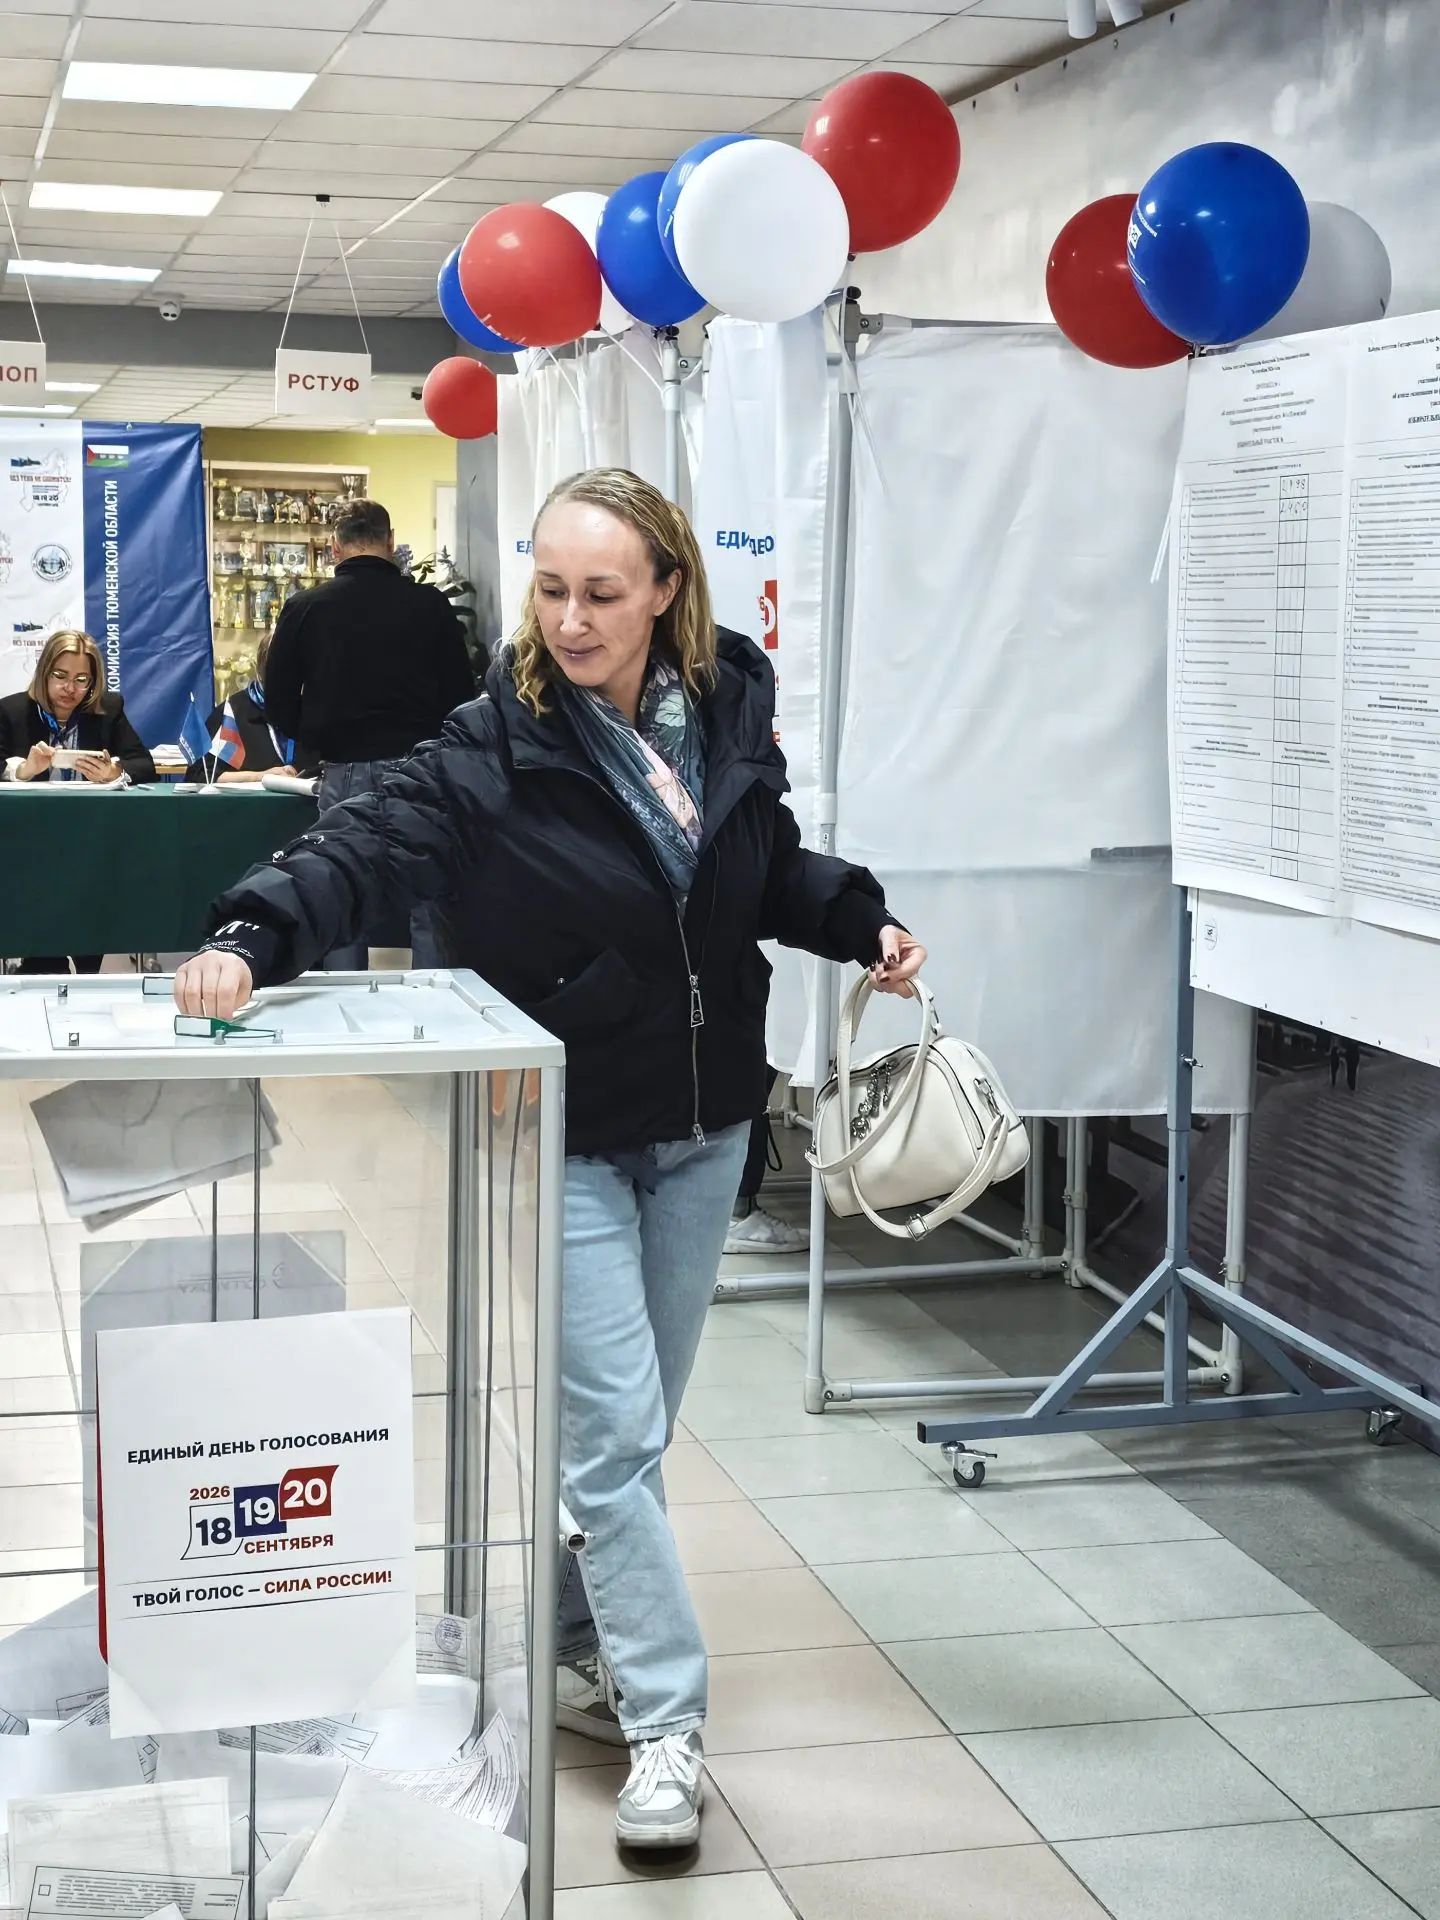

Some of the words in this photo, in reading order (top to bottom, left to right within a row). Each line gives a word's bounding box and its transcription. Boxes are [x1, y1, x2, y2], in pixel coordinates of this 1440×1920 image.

[0, 365, 37, 383] ОП
[288, 373, 359, 392] РСТУФ
[104, 481, 118, 537] ОБЛАСТИ
[102, 542, 119, 620] ТЮМЕНСКОЙ
[107, 623, 120, 692] КОМИССИЯ
[127, 1441, 204, 1464] ЕДИНЫЙ
[208, 1440, 256, 1458] ДЕНЬ
[260, 1428, 389, 1451] ГОЛОСОВАНИЯ
[189, 1485, 231, 1501] 2026
[283, 1477, 328, 1509] 20
[239, 1496, 276, 1527] 19
[195, 1516, 233, 1546] 18
[244, 1534, 334, 1554] СЕНТЯБРЯ
[132, 1587, 181, 1607] ТВОЙ
[185, 1584, 244, 1602] ГОЛОС
[264, 1578, 312, 1594] СИЛА
[316, 1570, 392, 1589] РОССИИ!
